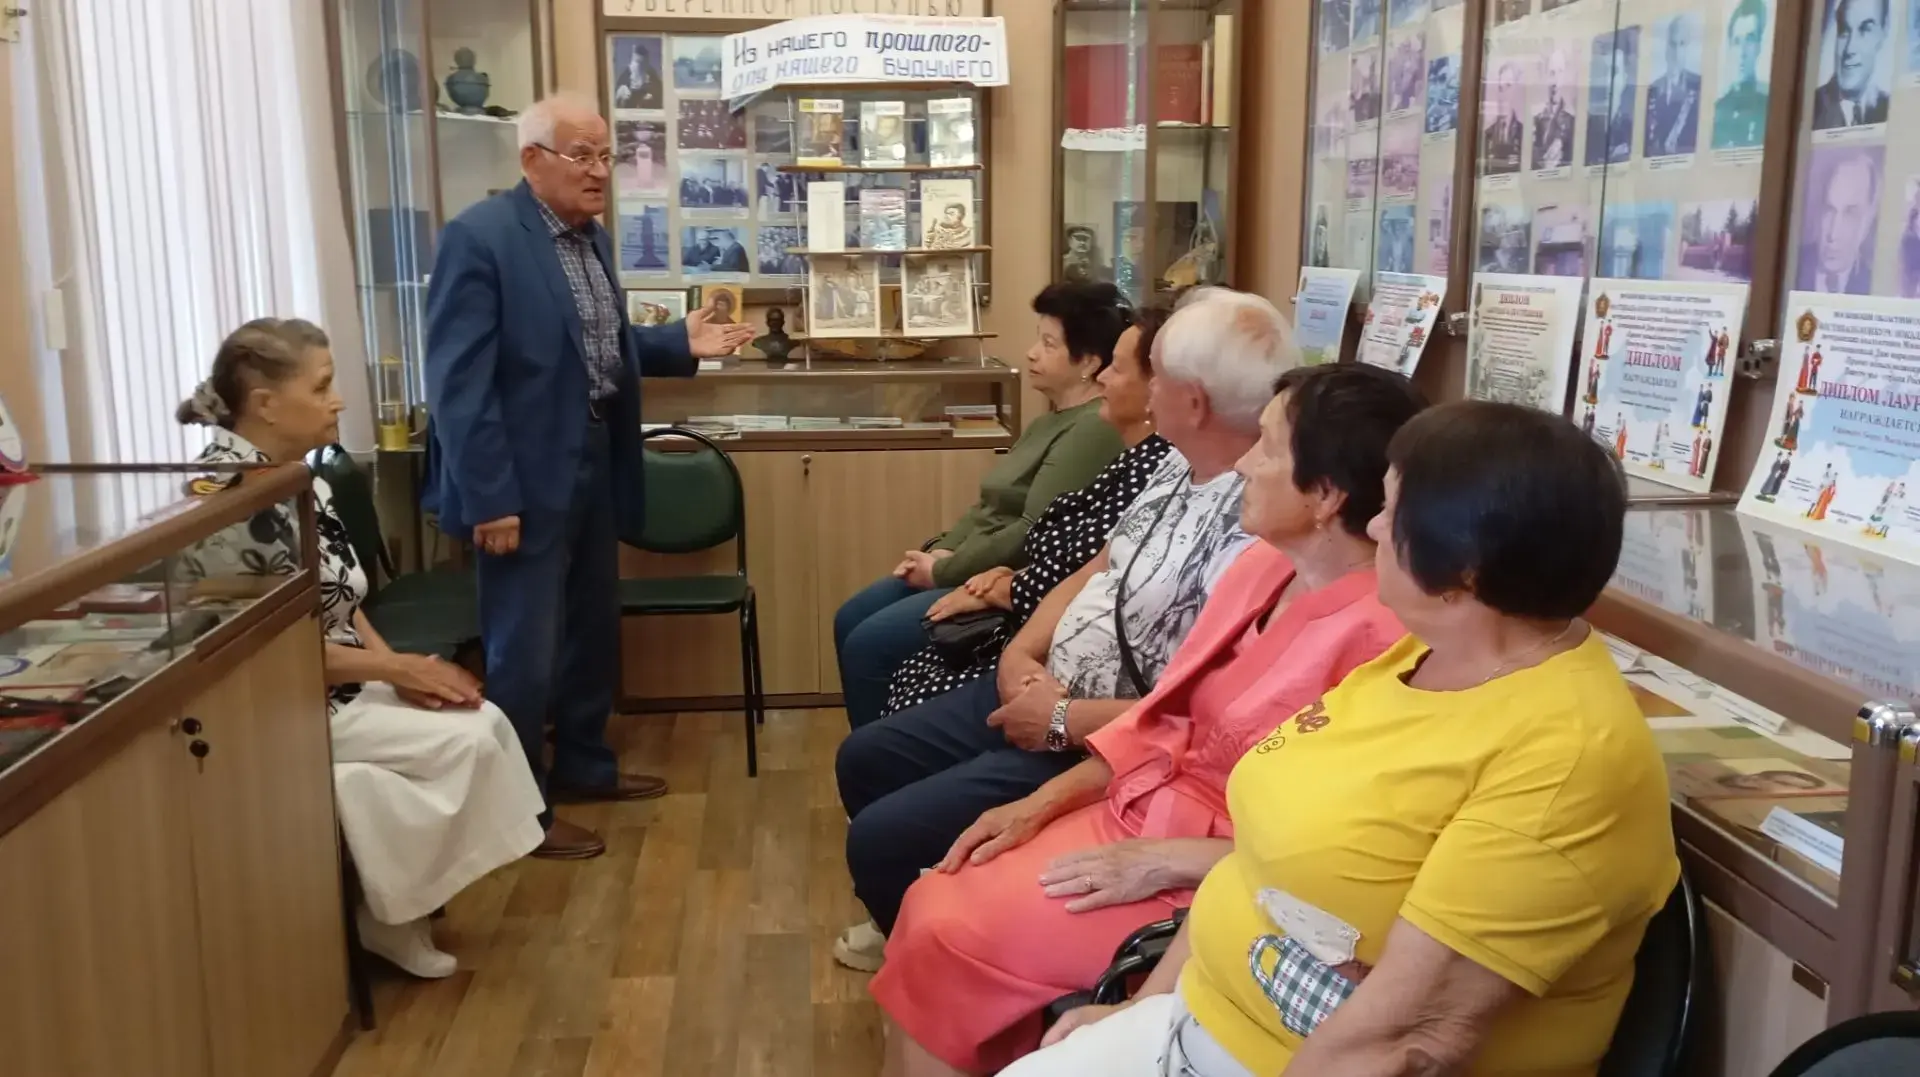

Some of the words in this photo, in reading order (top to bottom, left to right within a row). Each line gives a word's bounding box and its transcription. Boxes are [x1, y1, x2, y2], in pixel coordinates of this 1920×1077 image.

[733, 35, 757, 67] Из
[883, 57, 993, 79] БУДУЩЕГО
[1624, 349, 1682, 372] ДИПЛОМ
[1818, 381, 1880, 406] ДИПЛОМ
[1839, 408, 1920, 433] НАГРАЖДАЕТС
